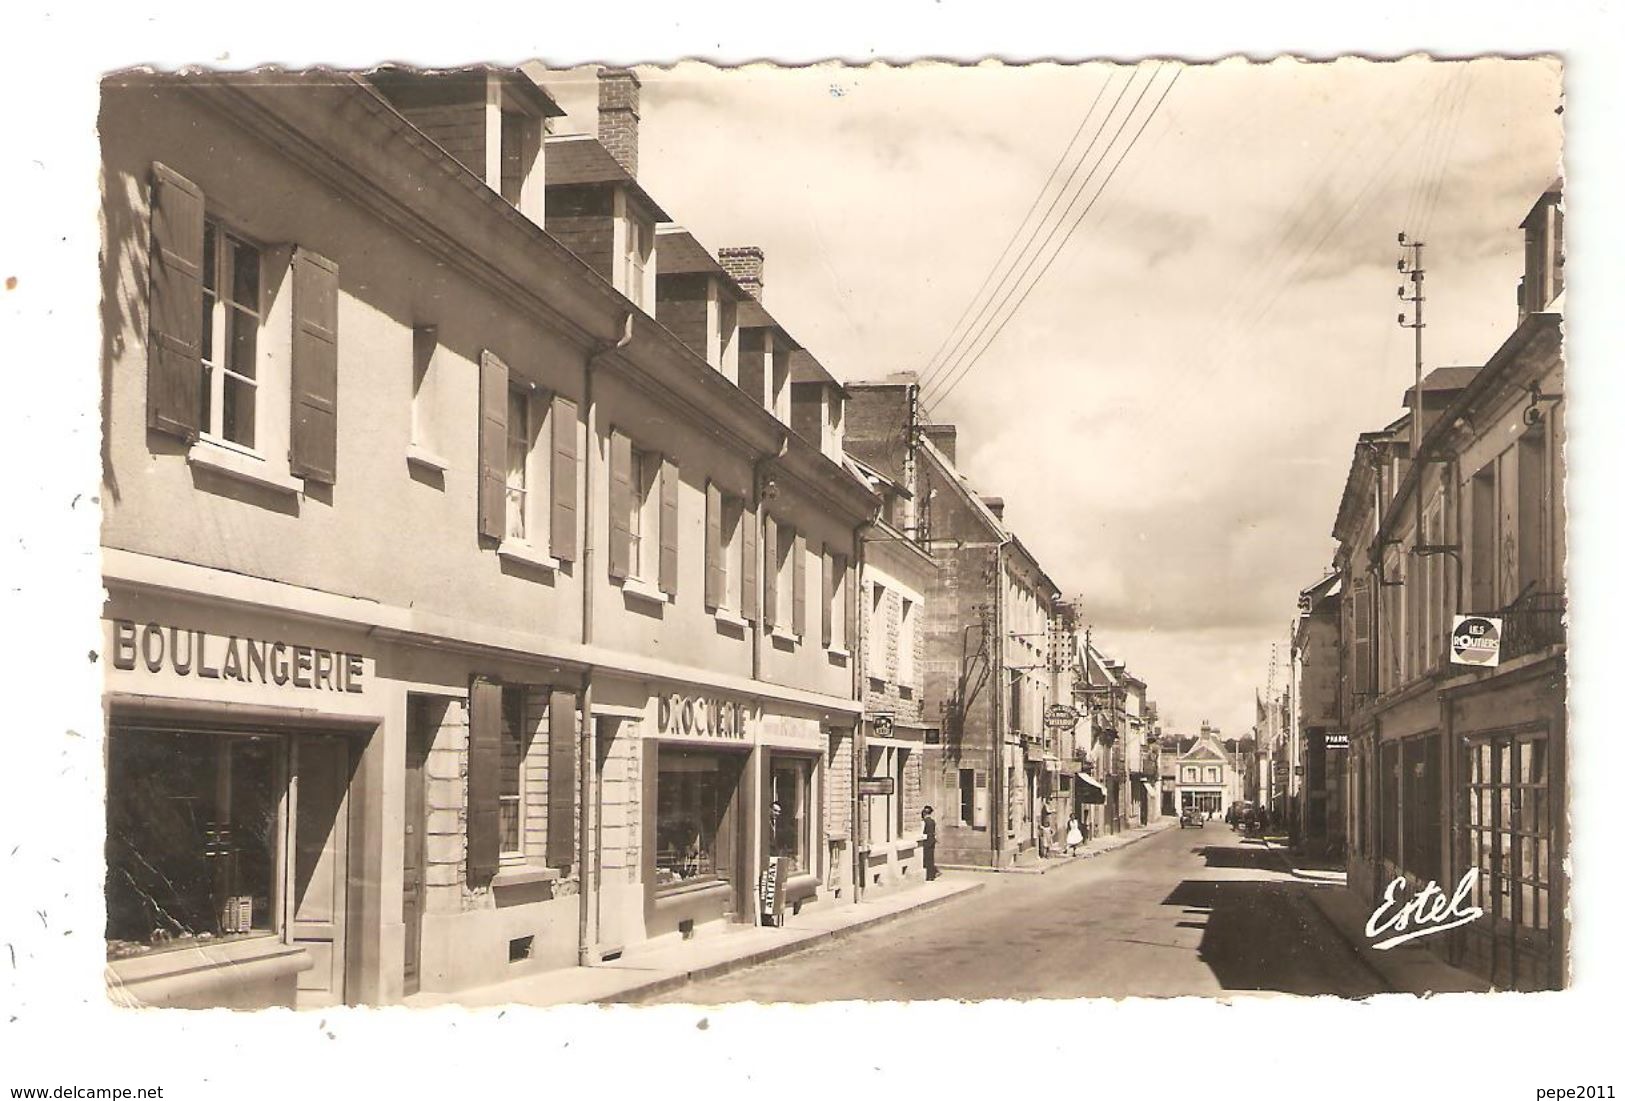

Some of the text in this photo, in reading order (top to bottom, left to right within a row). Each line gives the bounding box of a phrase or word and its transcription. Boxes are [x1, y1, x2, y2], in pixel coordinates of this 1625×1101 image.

[1453, 634, 1499, 649] ROUTIERS
[1469, 624, 1485, 634] LES
[112, 618, 364, 694] BOULANGERIE
[657, 693, 746, 740] DROGUERIE
